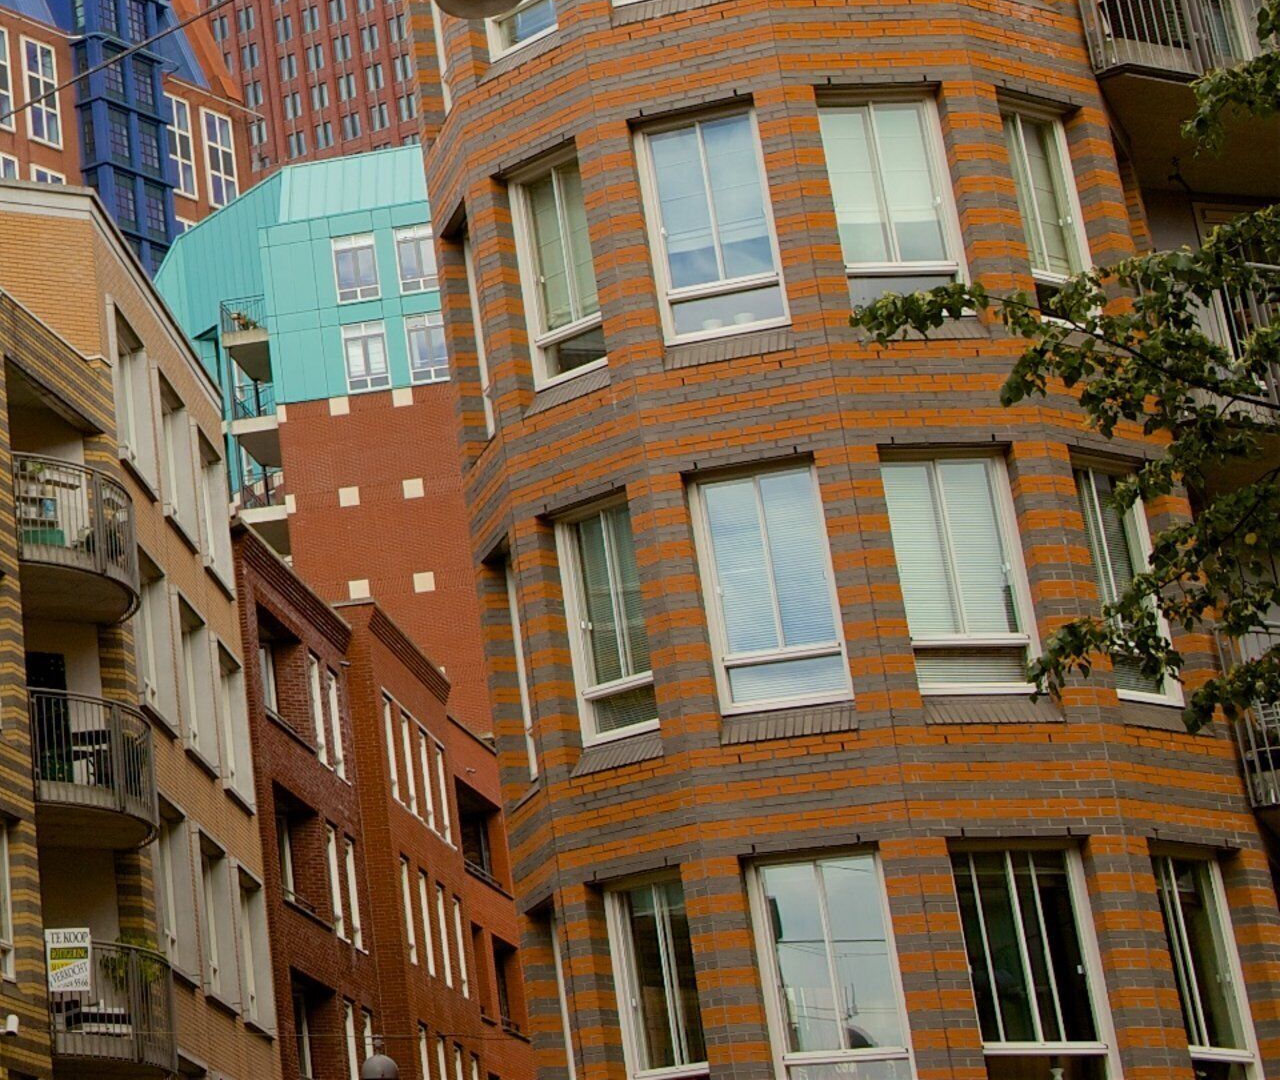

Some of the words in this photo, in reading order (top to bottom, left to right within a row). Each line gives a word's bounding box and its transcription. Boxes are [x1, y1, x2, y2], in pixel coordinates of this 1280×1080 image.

[51, 932, 62, 943] TE
[63, 931, 89, 943] KOOP
[51, 961, 88, 983] VERKOCHT
